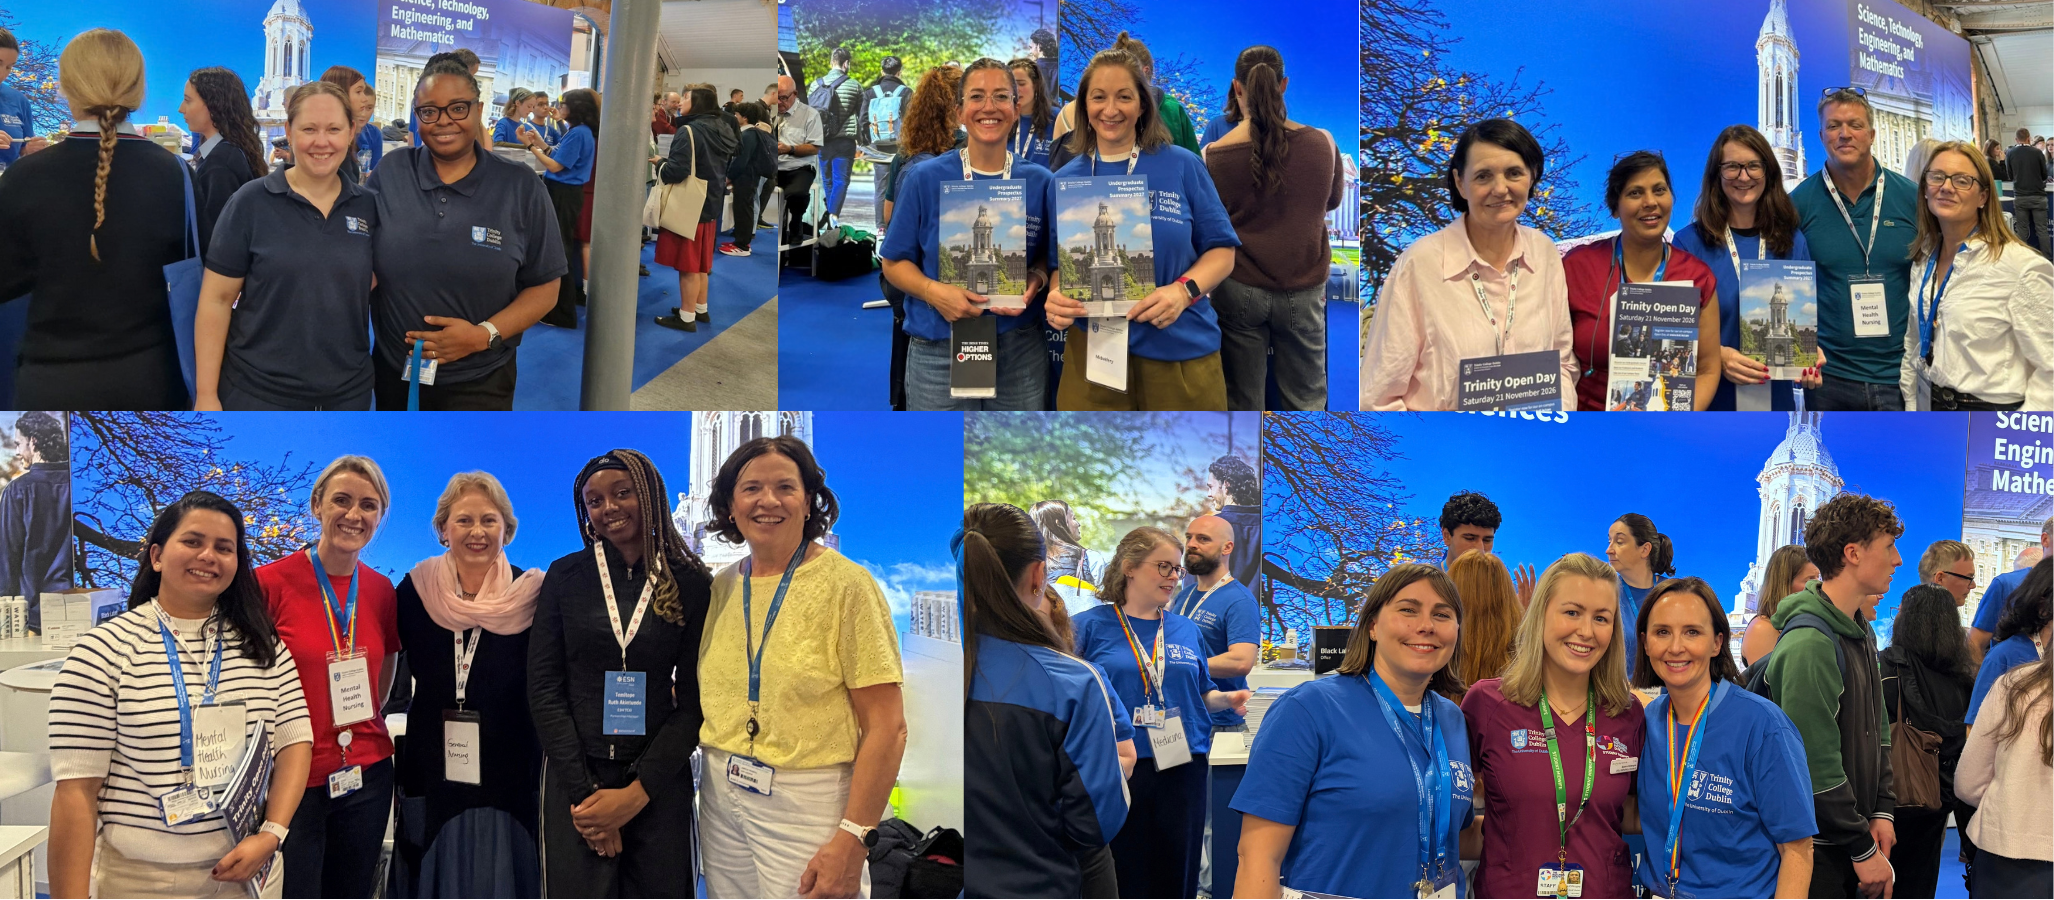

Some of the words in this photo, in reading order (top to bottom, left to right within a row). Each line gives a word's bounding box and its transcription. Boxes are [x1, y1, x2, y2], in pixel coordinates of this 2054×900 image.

[392, 5, 455, 31] Engineering,
[456, 18, 473, 31] and
[1857, 3, 1888, 34] Science,
[1888, 17, 1923, 49] Technology,
[391, 24, 454, 45] Mathematics
[1858, 27, 1903, 61] Engineering,
[1903, 47, 1914, 61] and
[1860, 51, 1904, 79] Mathematics
[1159, 190, 1181, 200] Trinity
[1159, 198, 1182, 208] College
[1159, 205, 1182, 215] Dublin
[1621, 301, 1652, 313] Trinity
[1653, 303, 1677, 313] Open
[1679, 304, 1696, 315] Day
[1619, 314, 1644, 322] Saturday
[957, 353, 992, 362] OPTIONS
[1463, 379, 1502, 393] Trinity
[1504, 376, 1534, 389] Open
[1536, 373, 1556, 384] Day
[1463, 395, 1494, 406] Saturday
[1505, 390, 1539, 400] November
[1541, 387, 1556, 395] 2026
[1994, 438, 2053, 469] Engin
[1992, 469, 2054, 496] Mathe
[341, 684, 360, 693] Mental
[342, 693, 361, 702] Health
[342, 702, 364, 712] Nursing
[196, 728, 227, 748] Mental
[1528, 729, 1545, 737] Trinity
[197, 747, 227, 763] Health
[1551, 751, 1560, 770] STUDENT
[199, 764, 236, 780] Nursing
[1709, 773, 1734, 786] Trinity
[232, 786, 253, 823] Trinity
[251, 759, 264, 788] Open
[1584, 777, 1592, 797] STUDENT
[1708, 783, 1733, 796] College
[1705, 792, 1732, 804] Dublin
[1690, 803, 1711, 813] University
